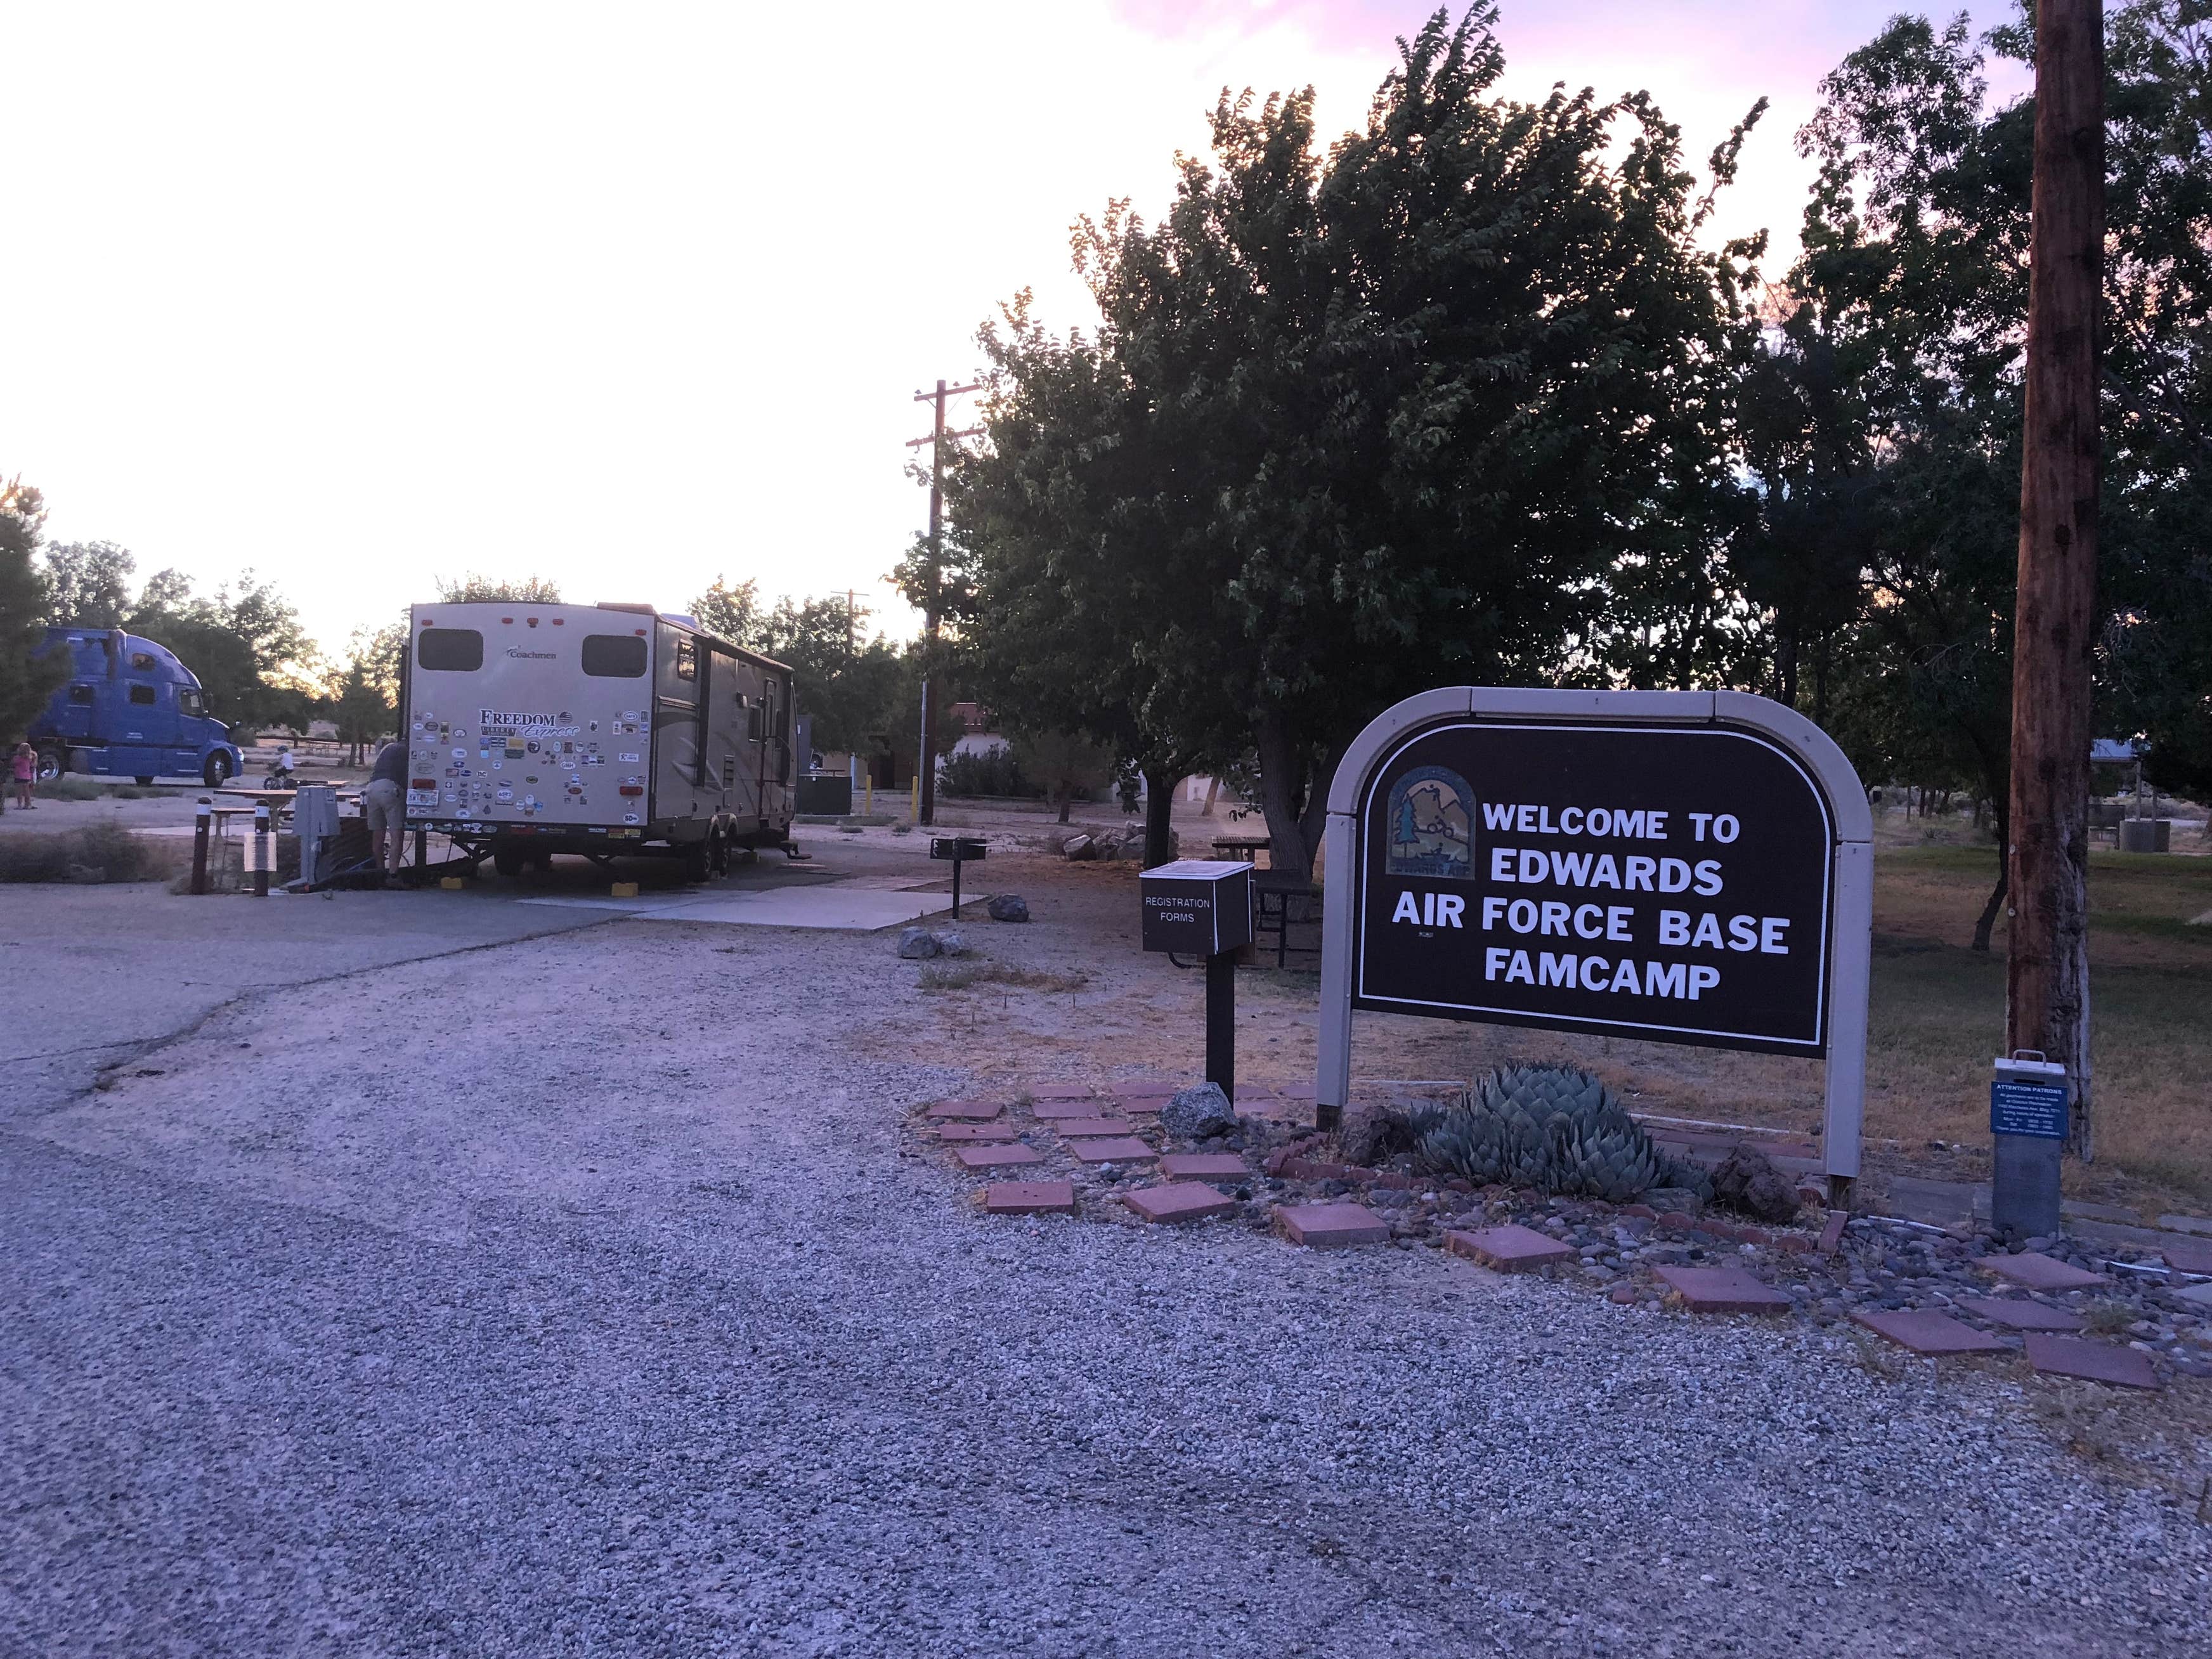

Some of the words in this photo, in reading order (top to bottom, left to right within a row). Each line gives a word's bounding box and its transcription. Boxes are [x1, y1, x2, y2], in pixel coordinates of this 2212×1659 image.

[509, 651, 557, 660] Coachmen
[480, 709, 556, 727] FREEDOM
[521, 724, 579, 738] Express
[1483, 803, 1668, 840] WELCOME
[1688, 812, 1740, 843] TO
[1491, 847, 1723, 896] EDWARDS
[1145, 897, 1210, 908] REGISTRATION
[1160, 912, 1195, 923] FORMS
[1392, 891, 1465, 928] AIR
[1482, 897, 1634, 942] FORCE
[1659, 909, 1790, 954] BASE
[1485, 947, 1721, 1001] FAMCAMP
